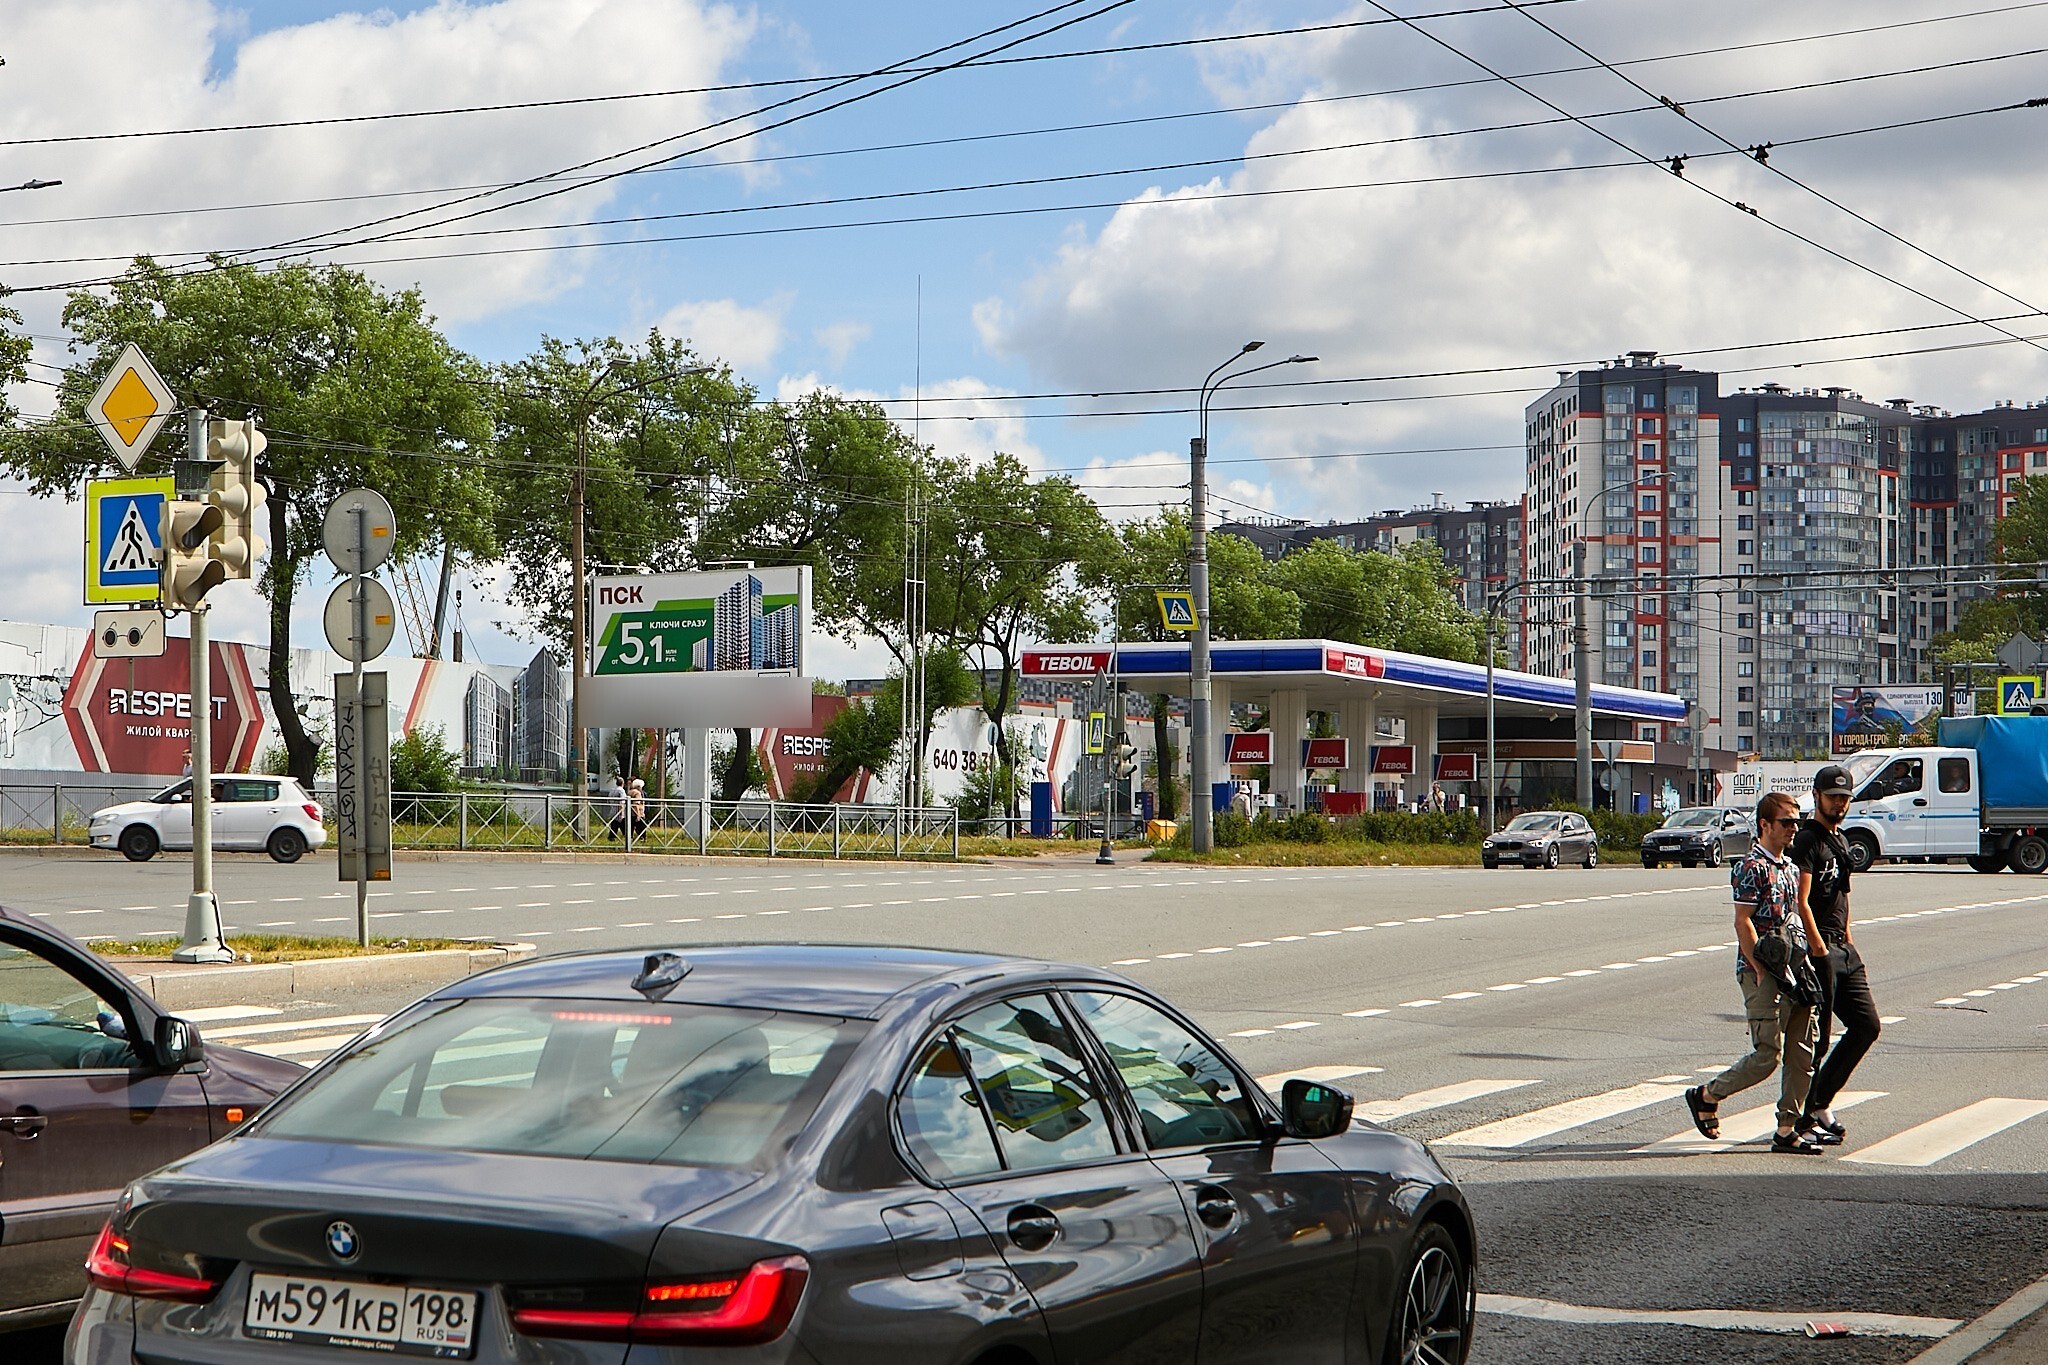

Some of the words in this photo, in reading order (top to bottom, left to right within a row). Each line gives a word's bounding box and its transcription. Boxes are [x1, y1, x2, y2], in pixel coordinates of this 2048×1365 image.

[600, 585, 643, 605] ПСК
[649, 620, 680, 629] КЛЮЧИ
[682, 619, 707, 628] СРАЗУ
[619, 621, 663, 666] 5,1
[1039, 656, 1095, 671] TEBOIL
[1344, 655, 1366, 673] TEBOIL
[110, 688, 227, 720] RESPET
[1925, 691, 1942, 705] 130
[126, 725, 161, 737] ЖИЛОЙ
[165, 729, 191, 738] КВАР
[783, 735, 833, 757] RESPE
[1844, 734, 1886, 746] ГОРОДА-ГЕРО
[933, 748, 958, 770] 640
[961, 750, 977, 771] 38
[1236, 751, 1265, 759] TEBOIL
[1313, 756, 1340, 764] TEBOIL
[1443, 769, 1469, 777] TEBOIL
[409, 1293, 465, 1328] 198
[416, 1327, 445, 1341] RUS
